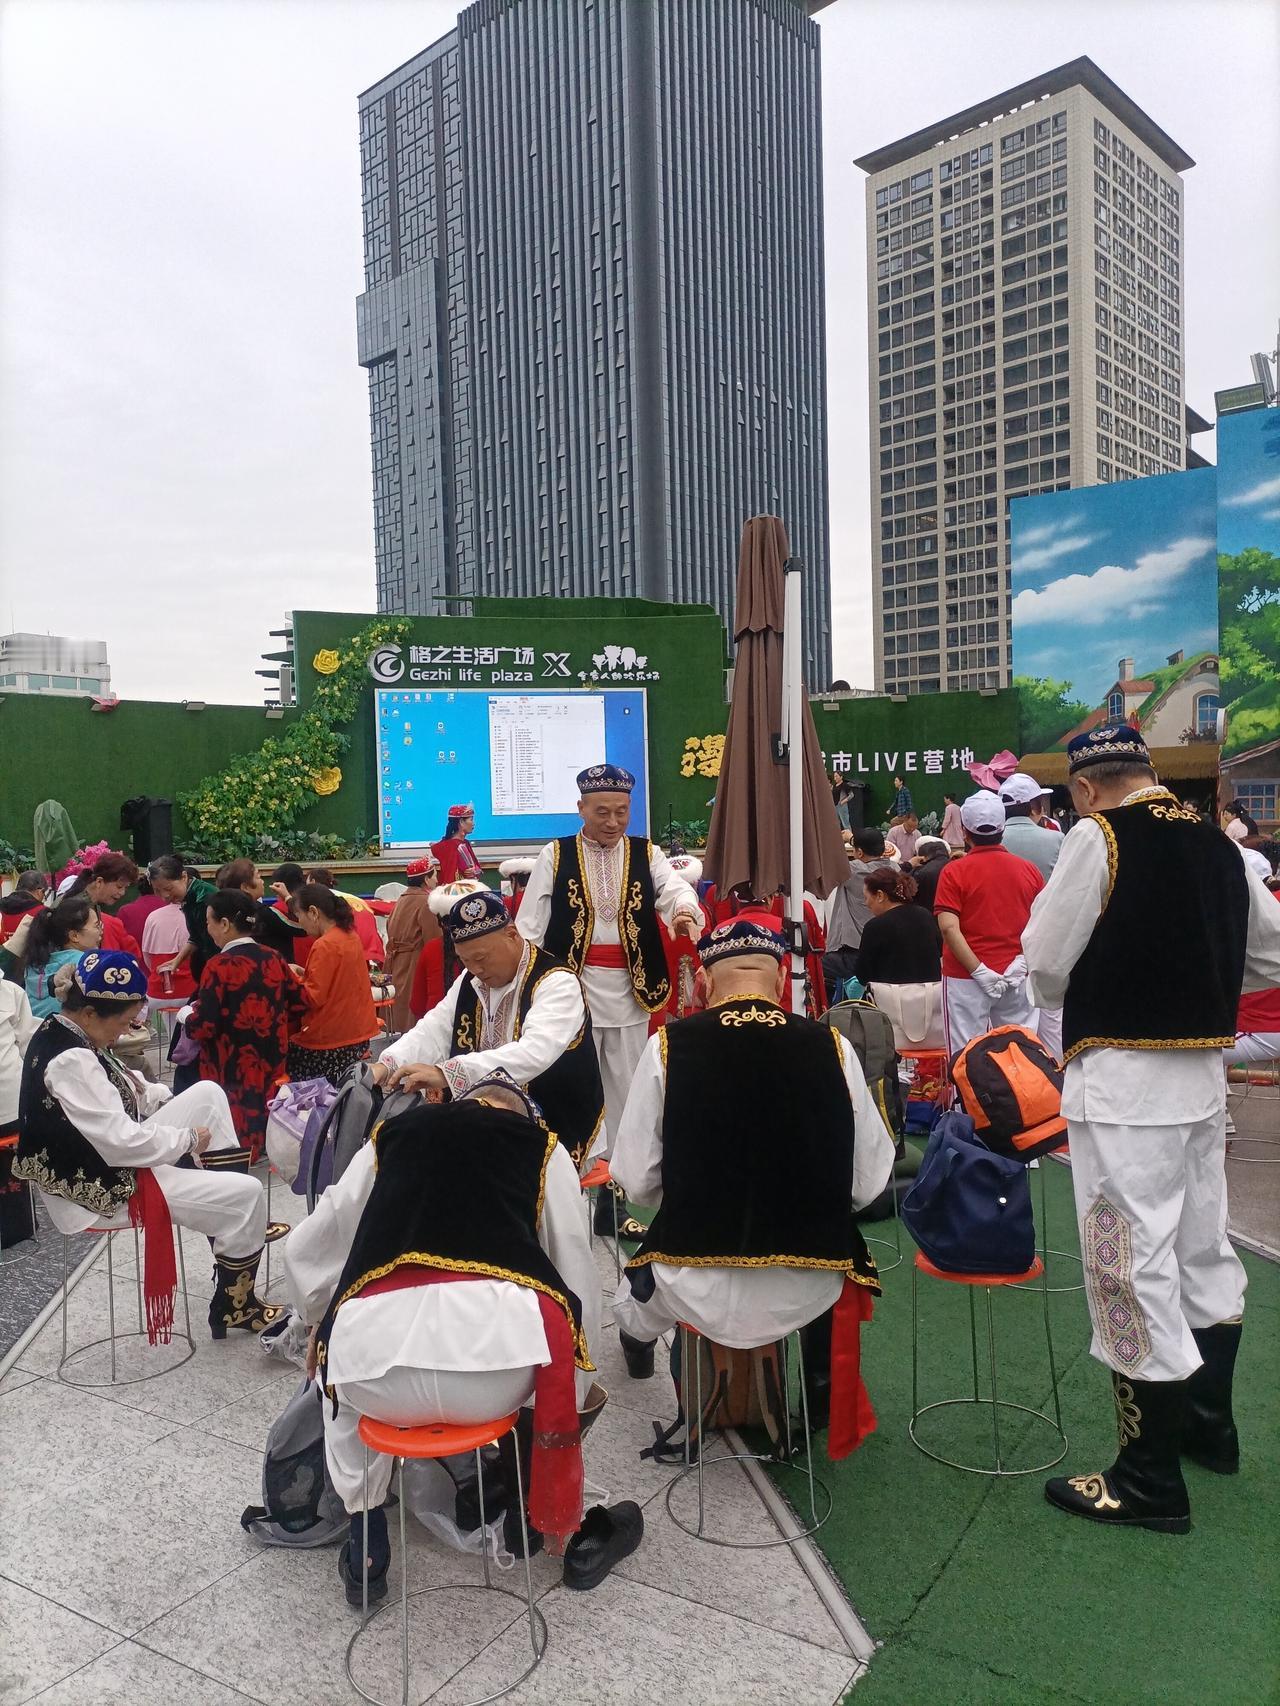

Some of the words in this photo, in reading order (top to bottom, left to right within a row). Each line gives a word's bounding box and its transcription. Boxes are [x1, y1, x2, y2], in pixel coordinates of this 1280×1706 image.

[409, 645, 535, 665] 格之生活广场
[409, 668, 451, 681] Gezhi
[459, 668, 482, 681] life
[491, 669, 533, 684] plaza
[820, 747, 974, 774] 市LIVE营地
